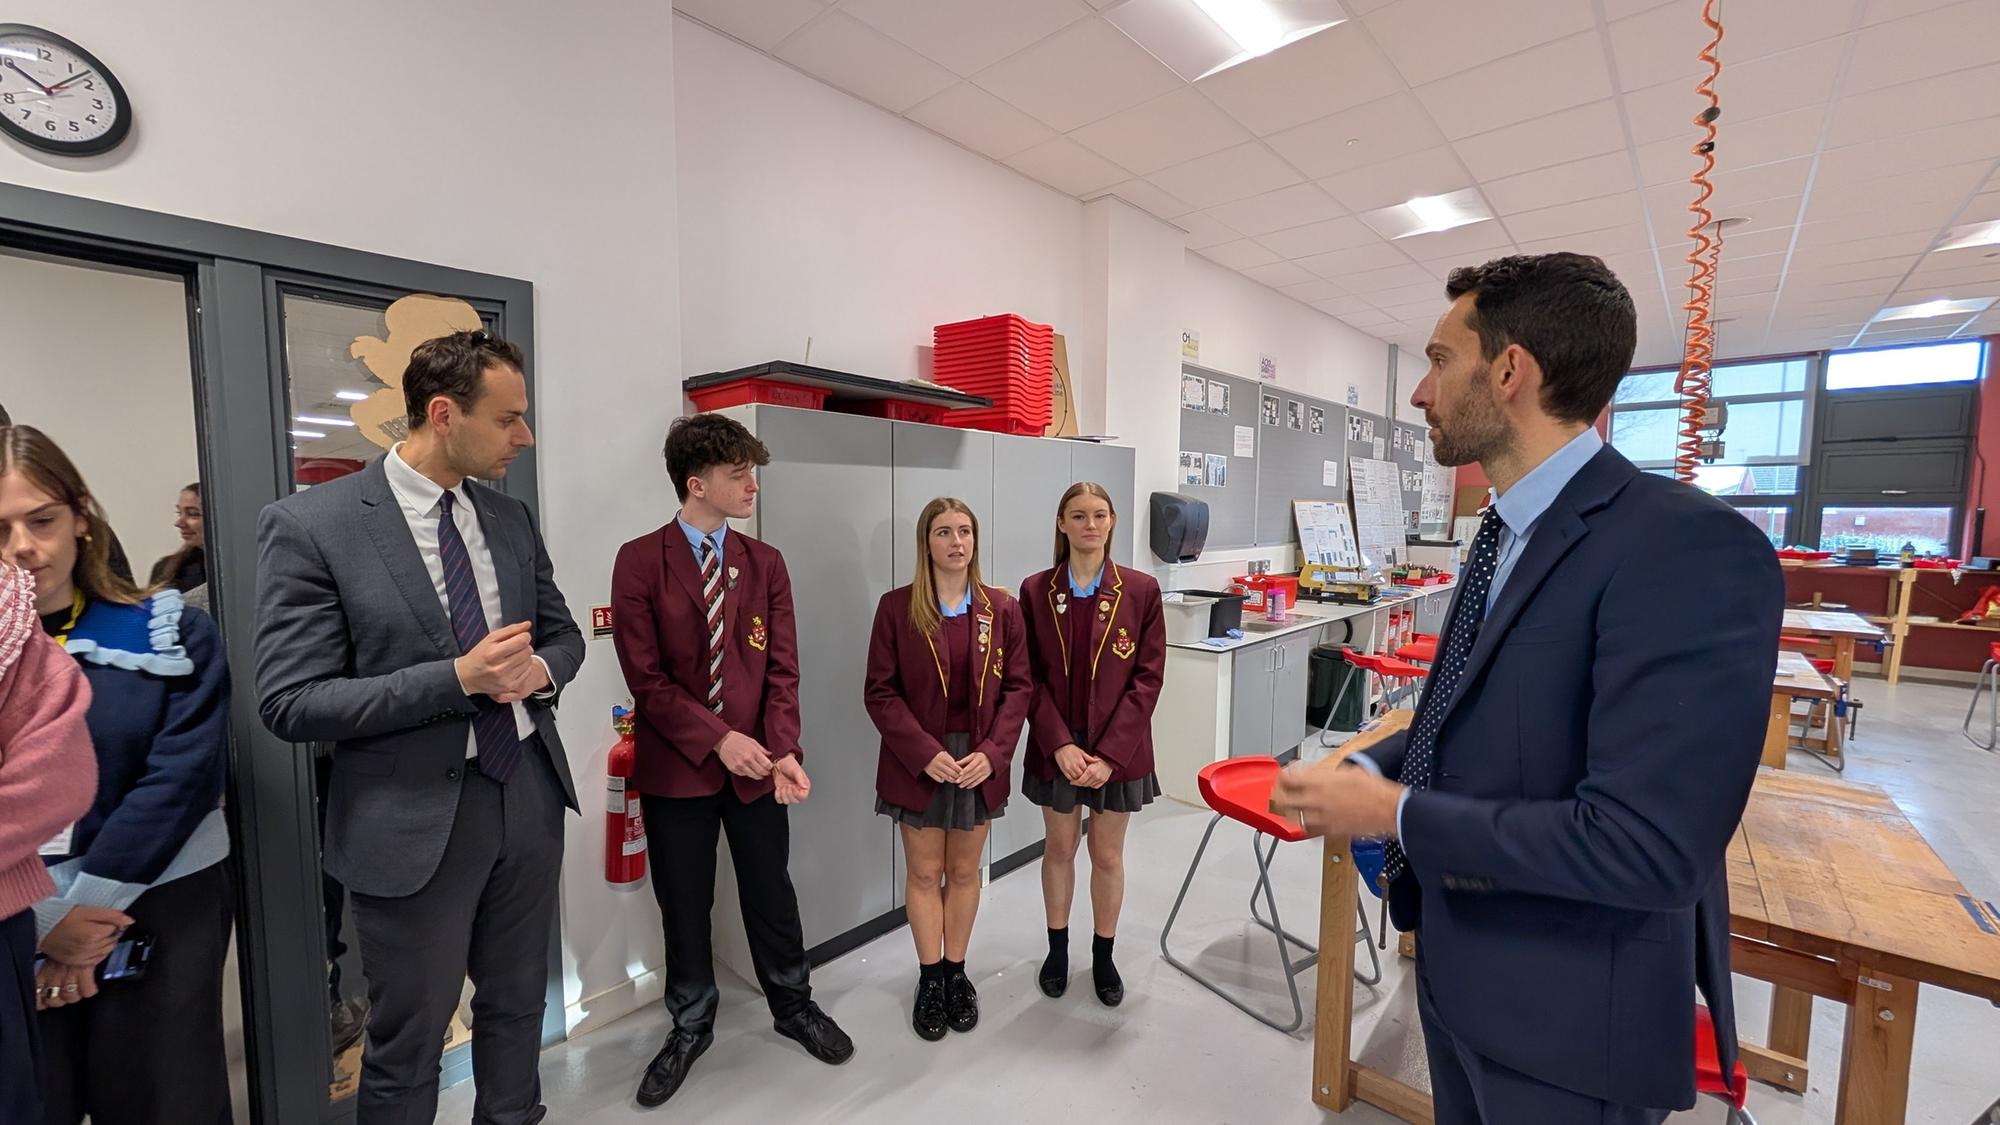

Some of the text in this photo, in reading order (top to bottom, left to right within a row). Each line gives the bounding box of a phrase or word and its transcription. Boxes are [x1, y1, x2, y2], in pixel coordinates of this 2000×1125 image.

[36, 48, 53, 62] 12
[68, 63, 73, 73] 1
[83, 79, 94, 91] 2
[4, 93, 15, 104] 8
[92, 98, 103, 110] 3
[20, 109, 31, 120] 7
[85, 114, 97, 124] 4
[45, 120, 56, 131] 6
[69, 121, 80, 132] 5
